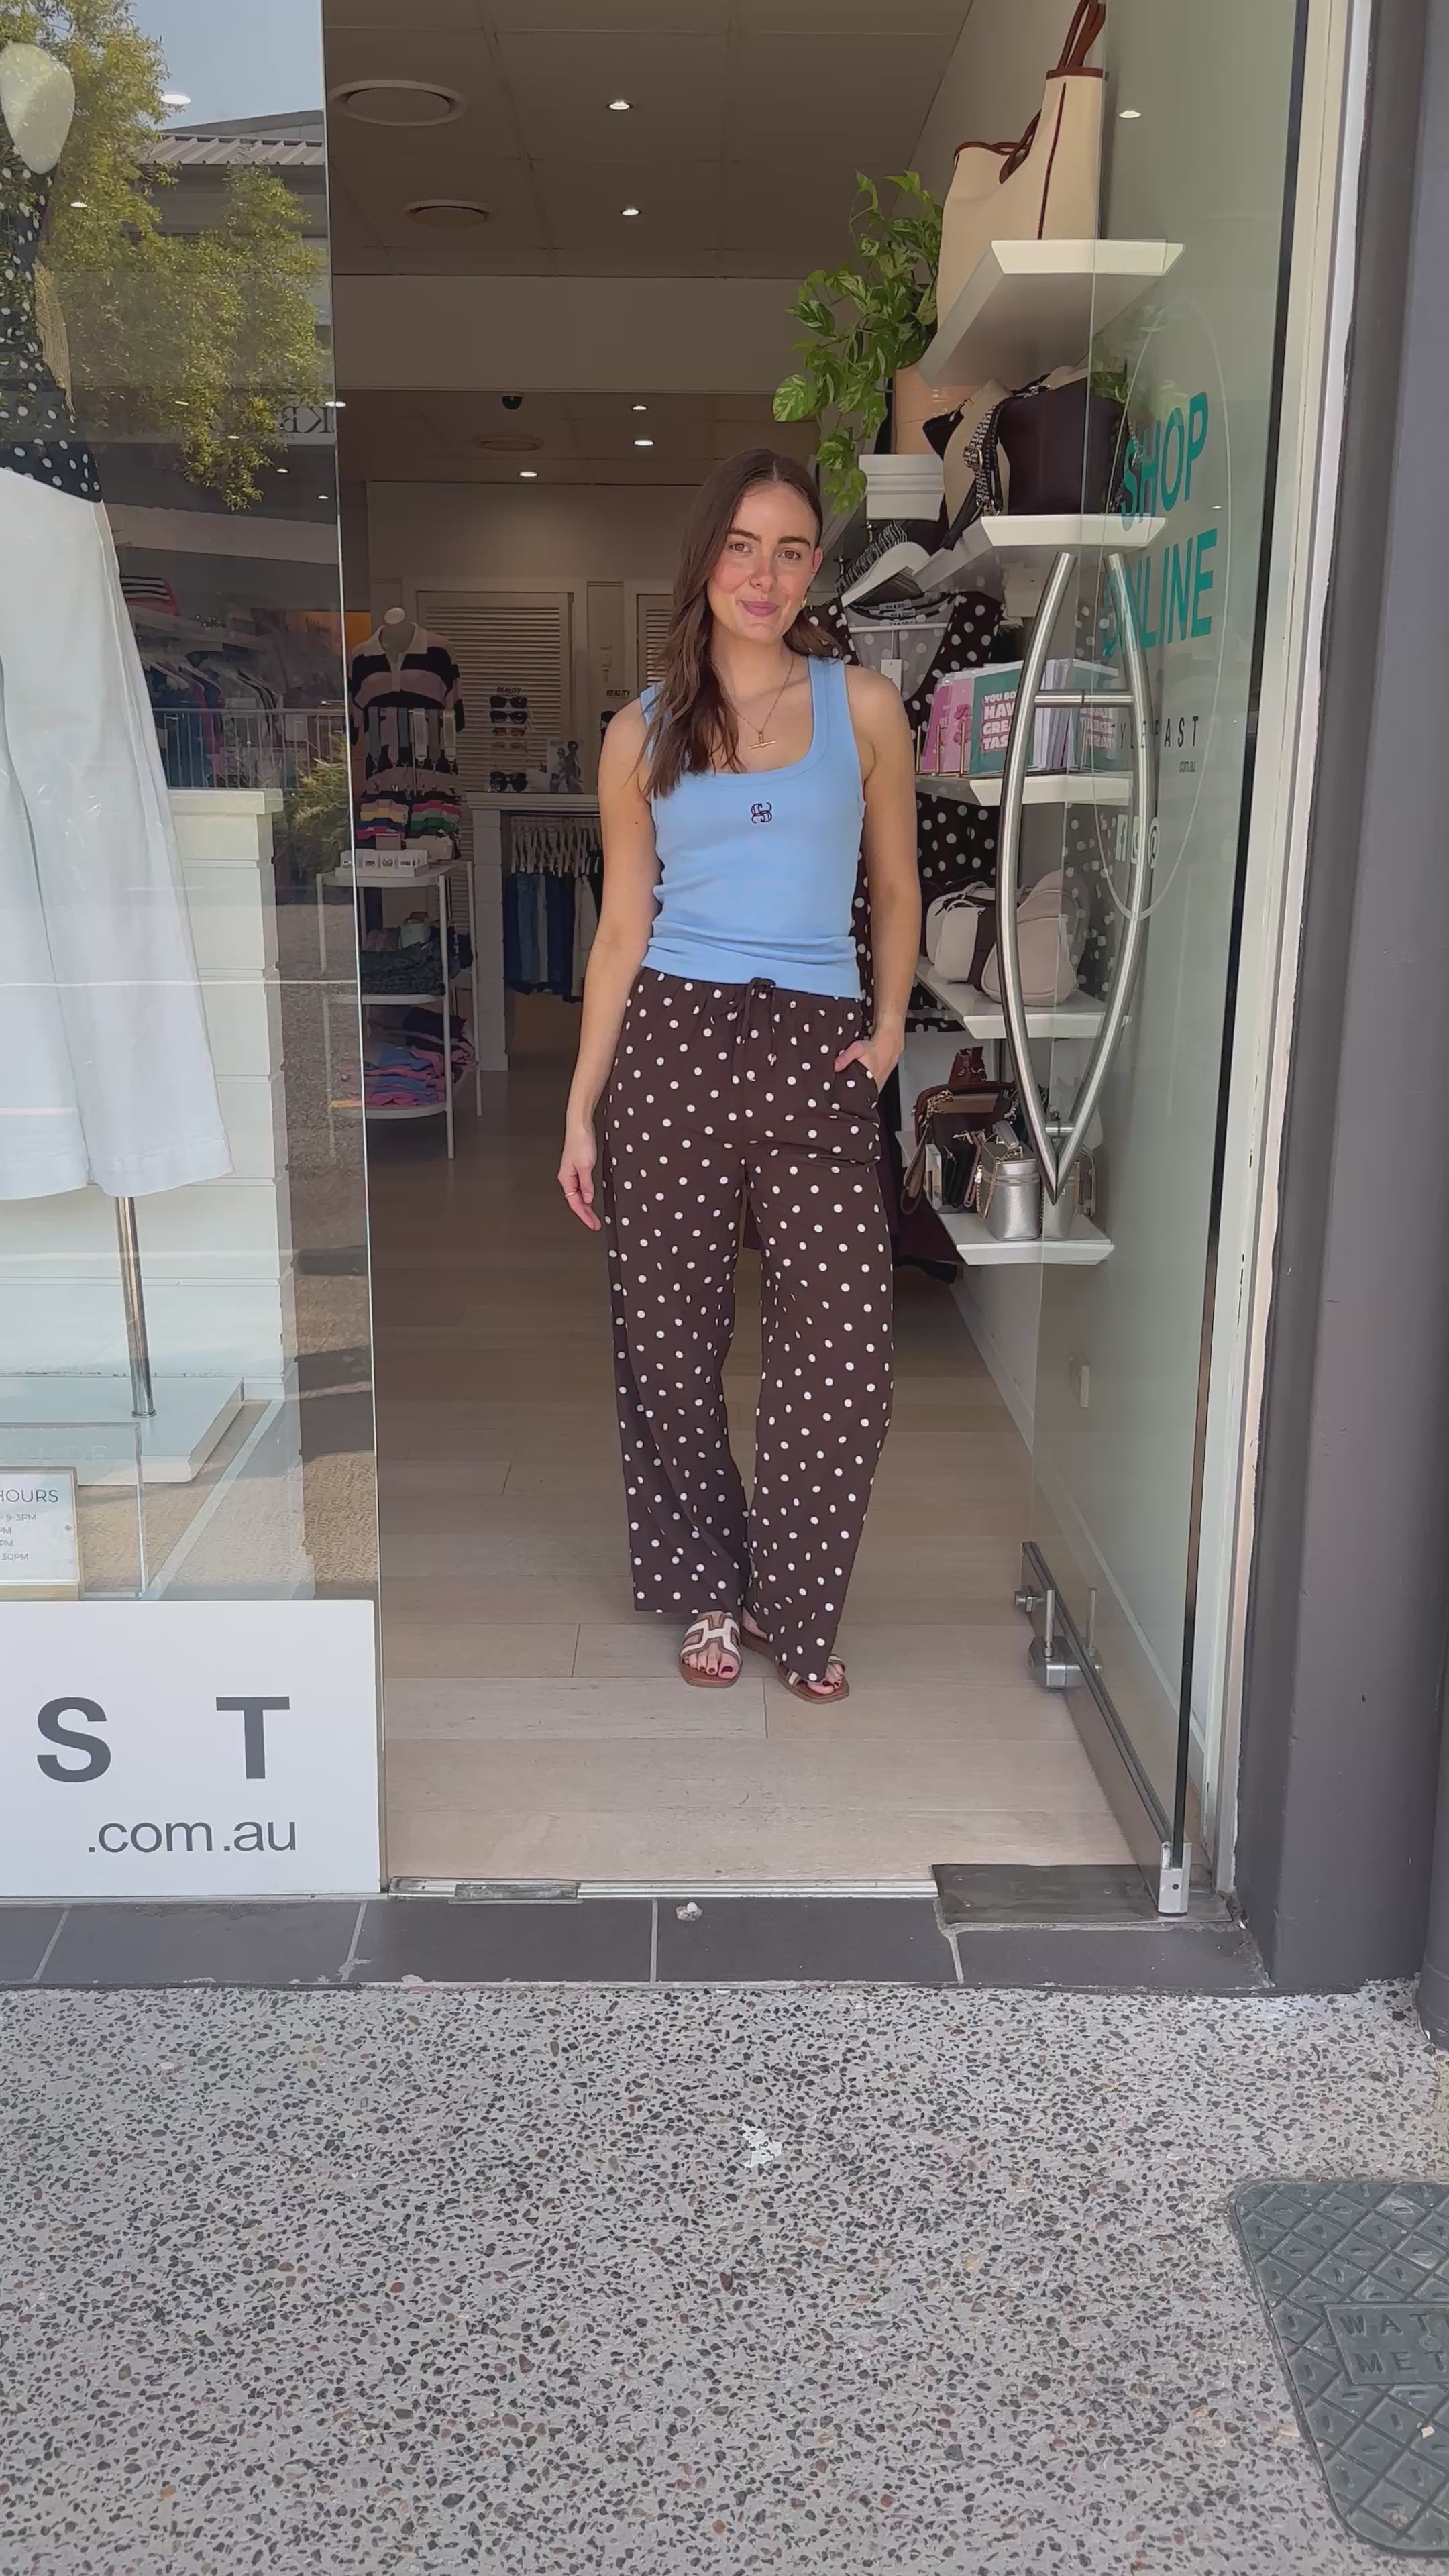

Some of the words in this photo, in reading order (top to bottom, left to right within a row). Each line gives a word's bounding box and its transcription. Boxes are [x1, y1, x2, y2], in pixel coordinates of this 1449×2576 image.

[1121, 391, 1208, 531] SHOP
[985, 694, 1002, 703] YOU
[983, 719, 1012, 736] GRE
